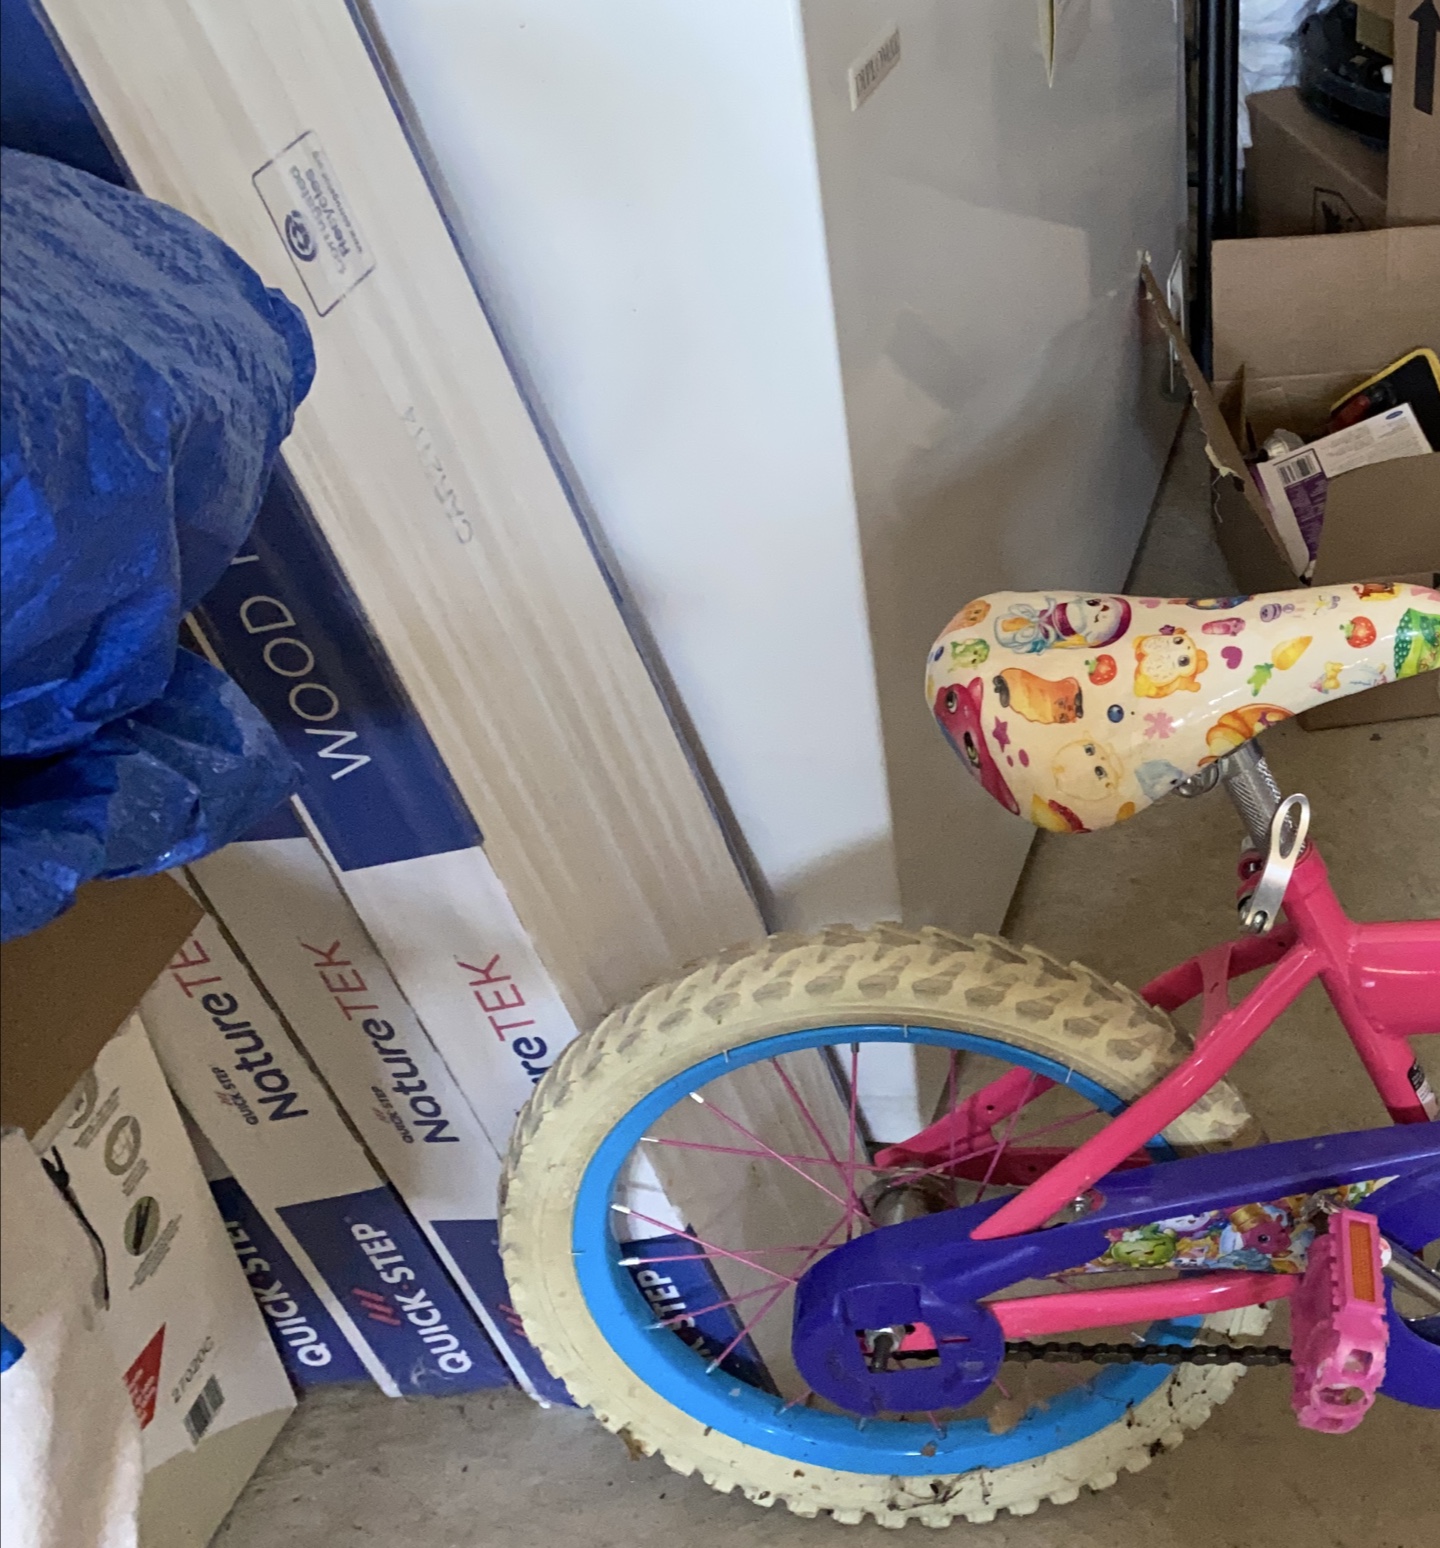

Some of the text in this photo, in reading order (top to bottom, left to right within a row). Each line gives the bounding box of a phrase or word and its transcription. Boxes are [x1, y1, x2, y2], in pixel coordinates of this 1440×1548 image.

[240, 596, 372, 780] WOOD
[170, 940, 308, 1121] NatureTE
[255, 1279, 331, 1366] QUICK
[349, 1222, 473, 1378] QUICK STEP
